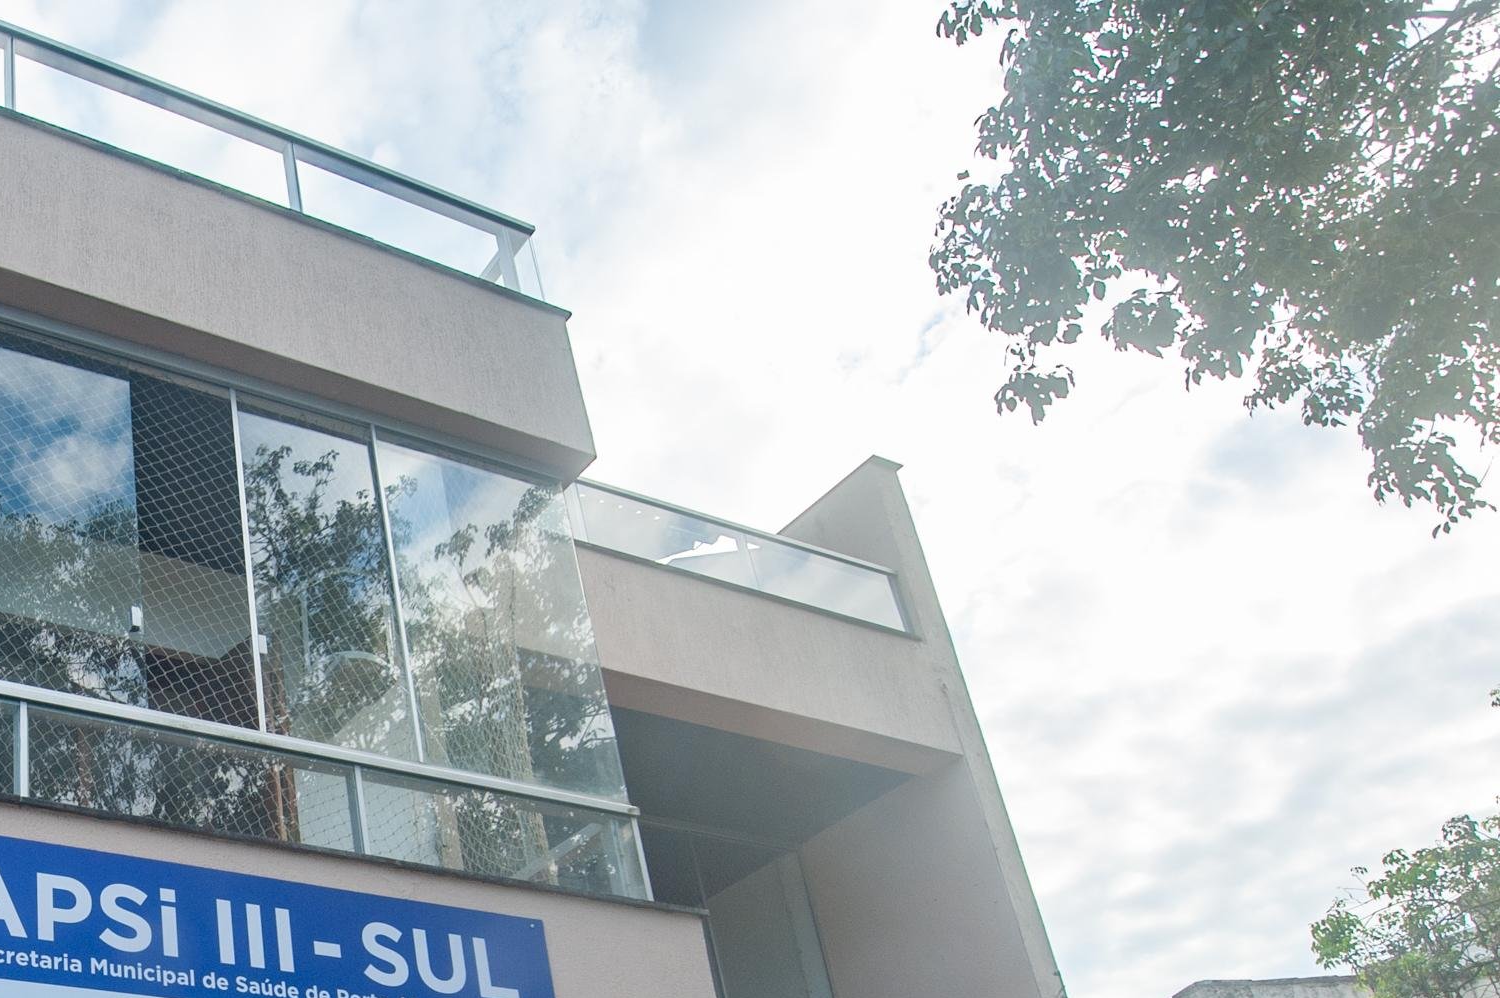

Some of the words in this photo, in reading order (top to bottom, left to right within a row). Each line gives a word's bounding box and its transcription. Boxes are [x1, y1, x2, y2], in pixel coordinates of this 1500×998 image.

[90, 957, 196, 987] Municipal
[202, 972, 229, 990] de
[236, 976, 299, 998] Saúde
